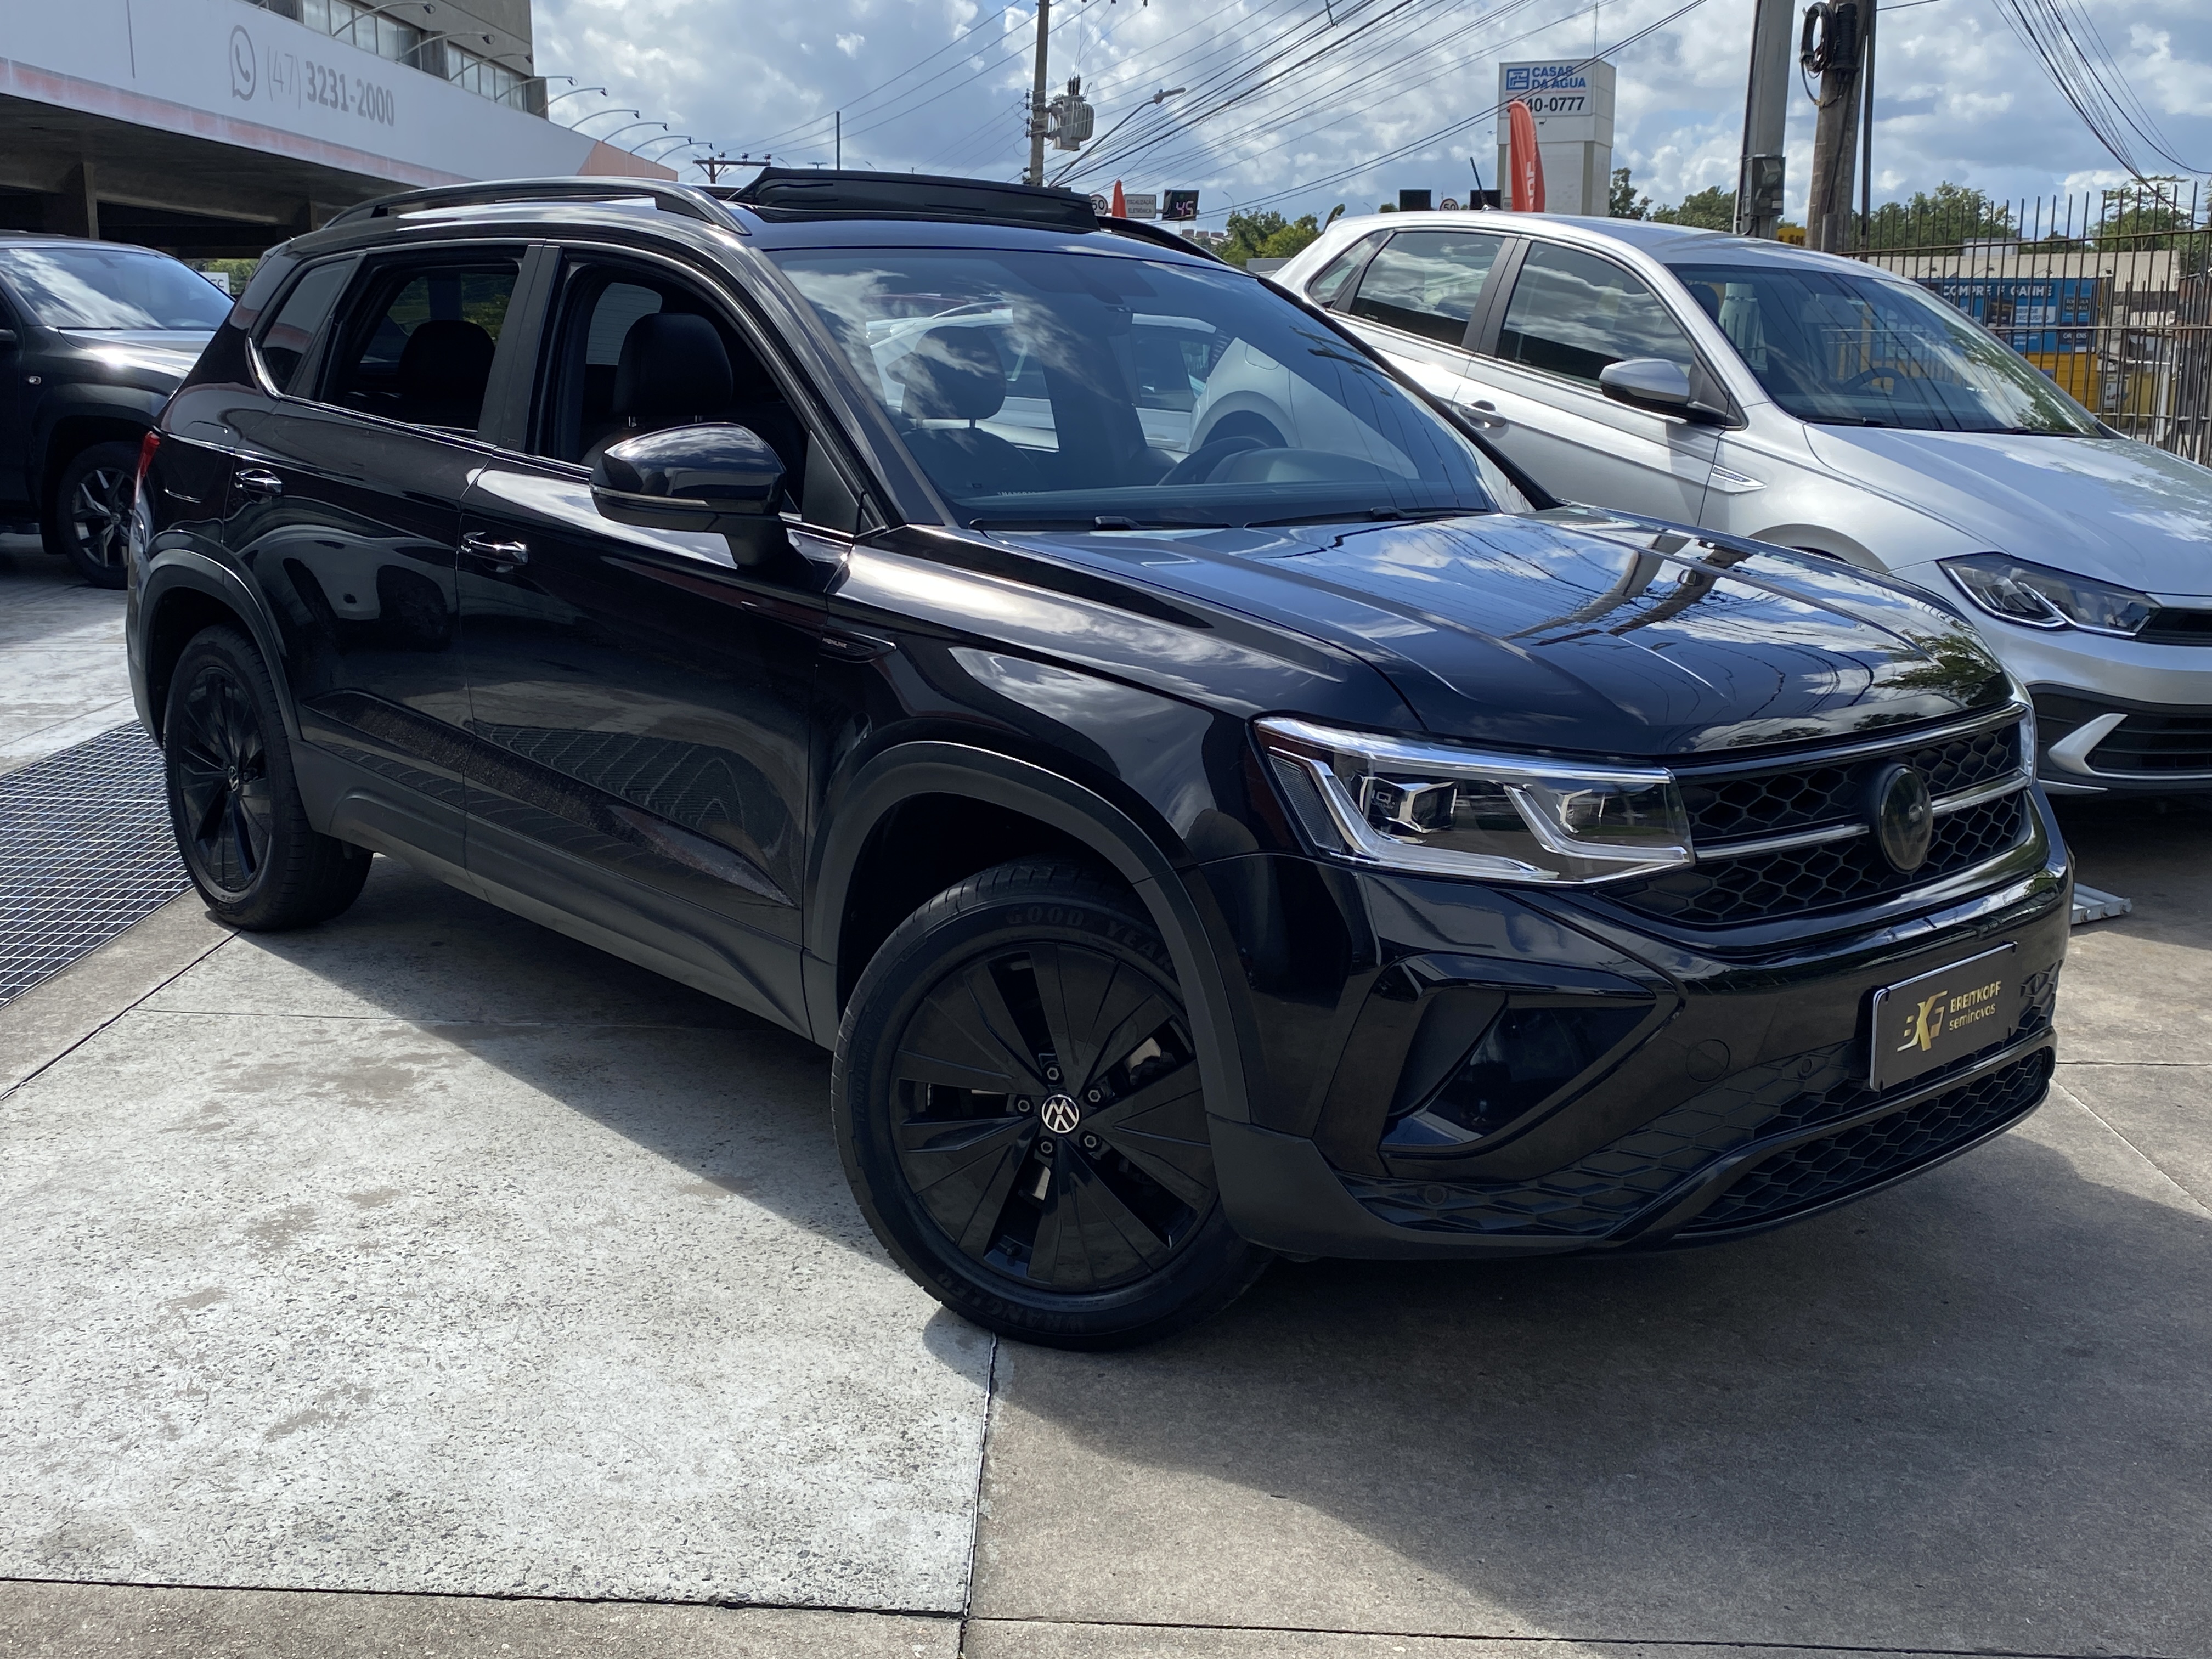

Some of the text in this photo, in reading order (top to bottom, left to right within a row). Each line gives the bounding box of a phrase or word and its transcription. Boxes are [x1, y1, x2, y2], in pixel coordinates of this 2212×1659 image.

[1532, 66, 1573, 78] CASAS
[267, 46, 394, 127] (47) 3231-2000
[1532, 79, 1548, 89] DA
[1091, 199, 1105, 210] 50
[1176, 200, 1194, 217] 45
[1443, 202, 1456, 211] 50
[1943, 285, 1991, 296] COMPRE
[2010, 285, 2052, 296] GANHE
[1006, 906, 1084, 926] GOOD
[1950, 980, 2002, 1014] BREITKOPF
[1949, 1003, 1996, 1031] seminovos
[936, 1269, 1085, 1332] WRANGLER
